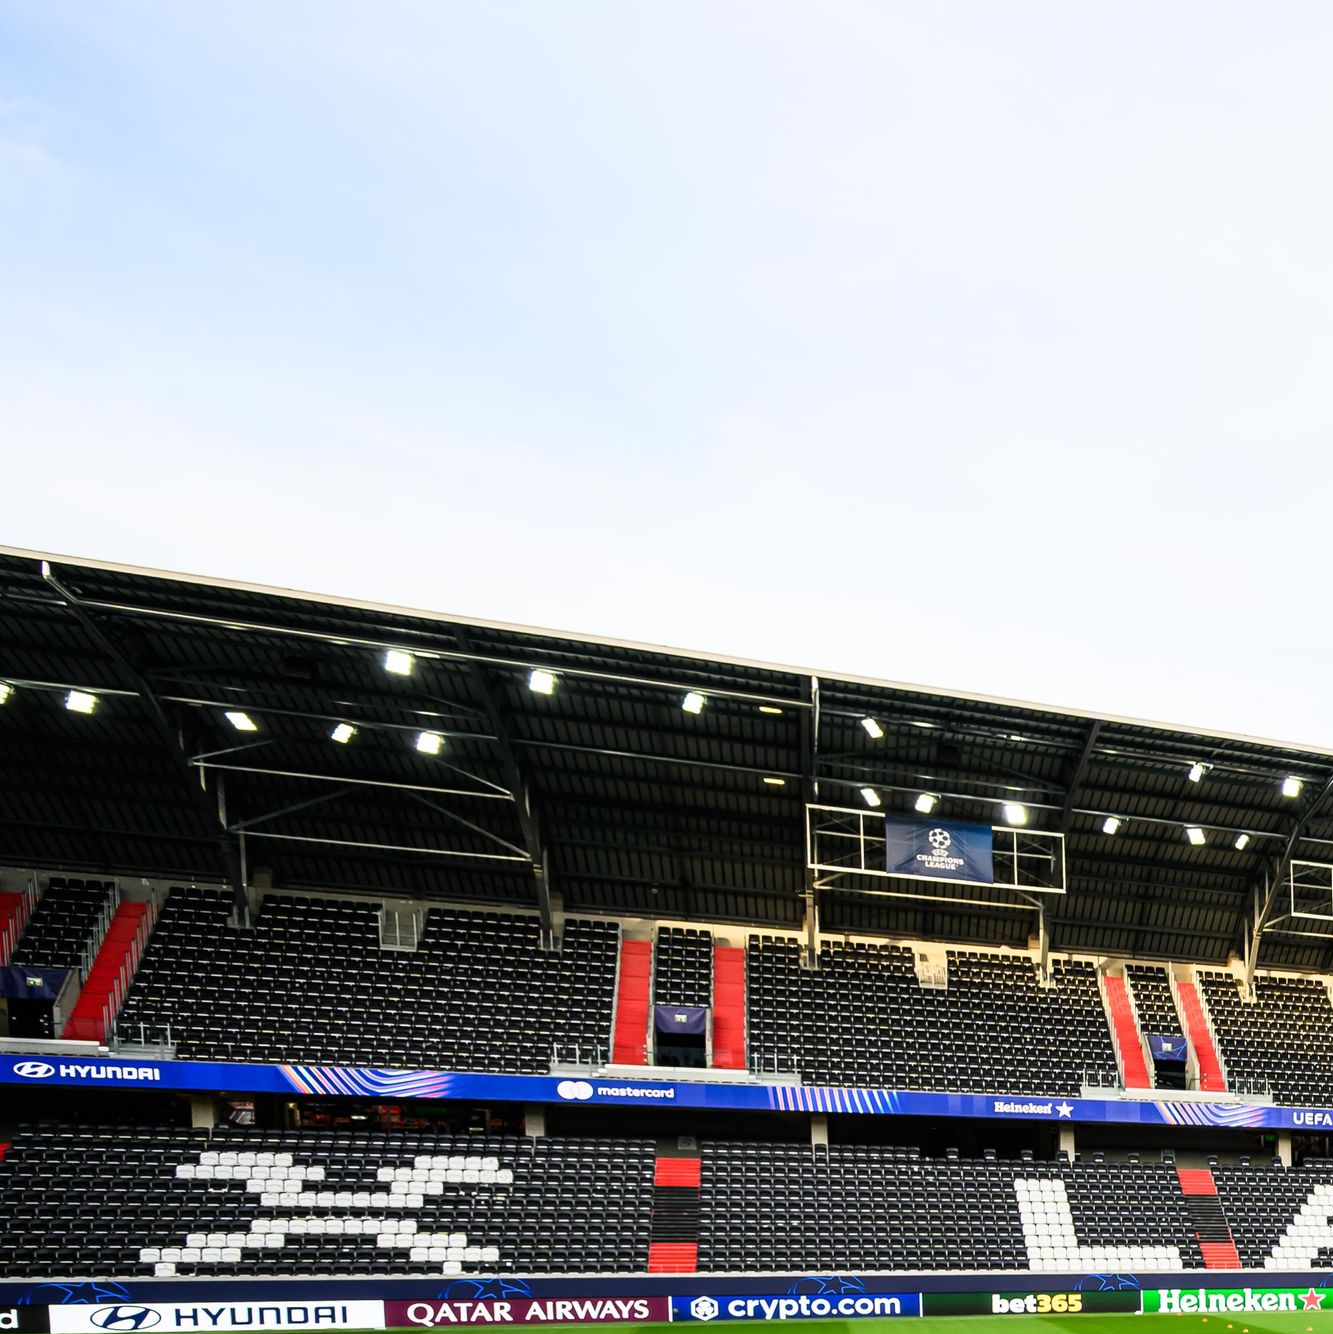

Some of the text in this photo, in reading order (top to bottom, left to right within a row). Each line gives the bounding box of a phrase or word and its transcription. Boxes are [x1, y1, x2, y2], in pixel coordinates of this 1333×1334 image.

[916, 854, 964, 866] CHAMPIONS
[925, 861, 956, 870] LEAGUE
[59, 1064, 160, 1081] HYUNDAI
[597, 1085, 675, 1099] mastercard
[994, 1101, 1052, 1115] Heineken
[1292, 1112, 1332, 1126] UEFA
[727, 1295, 900, 1320] crypto.com
[991, 1294, 1083, 1313] bet365
[1157, 1289, 1297, 1312] Heineken
[174, 1306, 348, 1327] HYUNDAI
[407, 1299, 650, 1327] QATAR AIRWAYS
